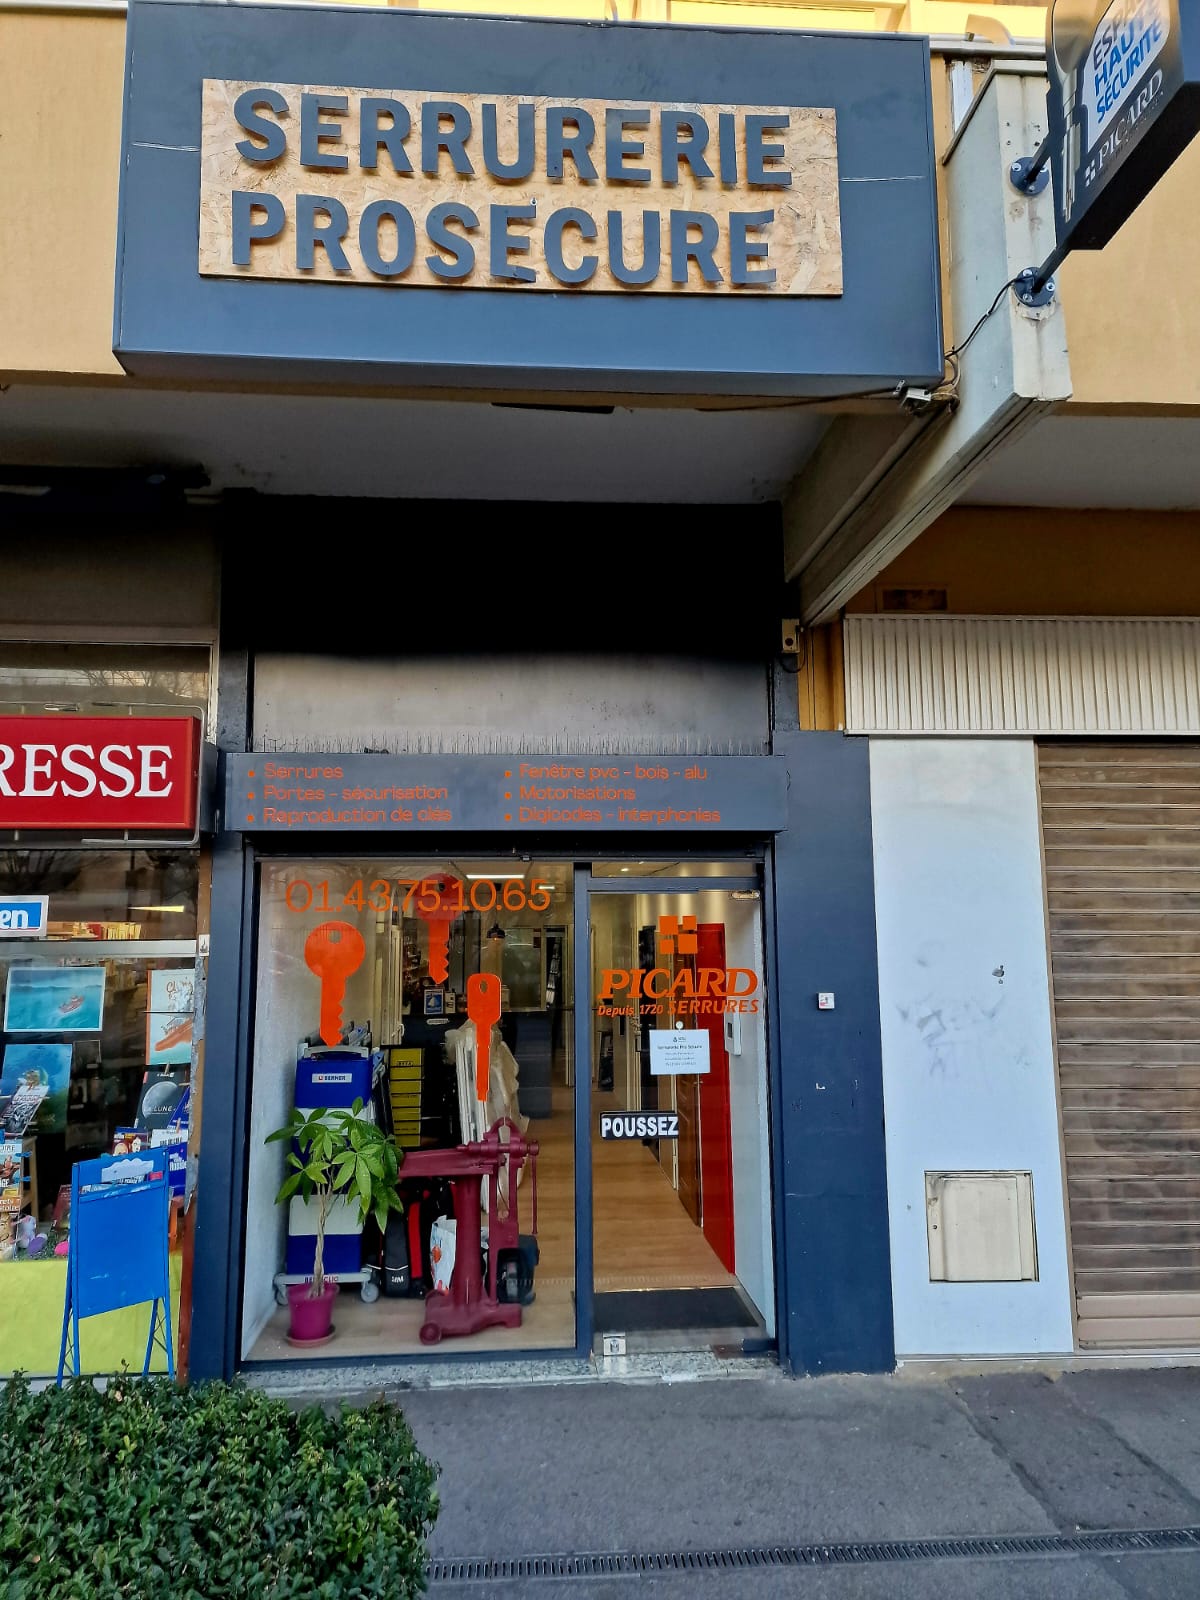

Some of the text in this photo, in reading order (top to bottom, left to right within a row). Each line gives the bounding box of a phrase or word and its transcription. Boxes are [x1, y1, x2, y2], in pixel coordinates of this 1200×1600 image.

[1099, 69, 1163, 170] PICARD
[233, 87, 793, 187] SERRURERIE
[231, 189, 778, 286] PROSECURE
[263, 762, 344, 779] Serrures
[519, 763, 585, 779] Fenêtre
[589, 767, 620, 782] pvc
[635, 763, 669, 780] bois
[684, 763, 707, 780] alu
[263, 784, 325, 801] Portes
[342, 784, 448, 801] sécurisation
[519, 785, 636, 801] Motorisations
[263, 806, 453, 827] Reproduction de clés
[519, 807, 602, 825] Digicodes
[285, 878, 551, 913] 01.43.75.10.65
[0, 909, 28, 929] en
[597, 968, 758, 999] PICARD
[597, 999, 759, 1018] Depuis 1720 SERRURES
[601, 1116, 679, 1138] POUSSEZ
